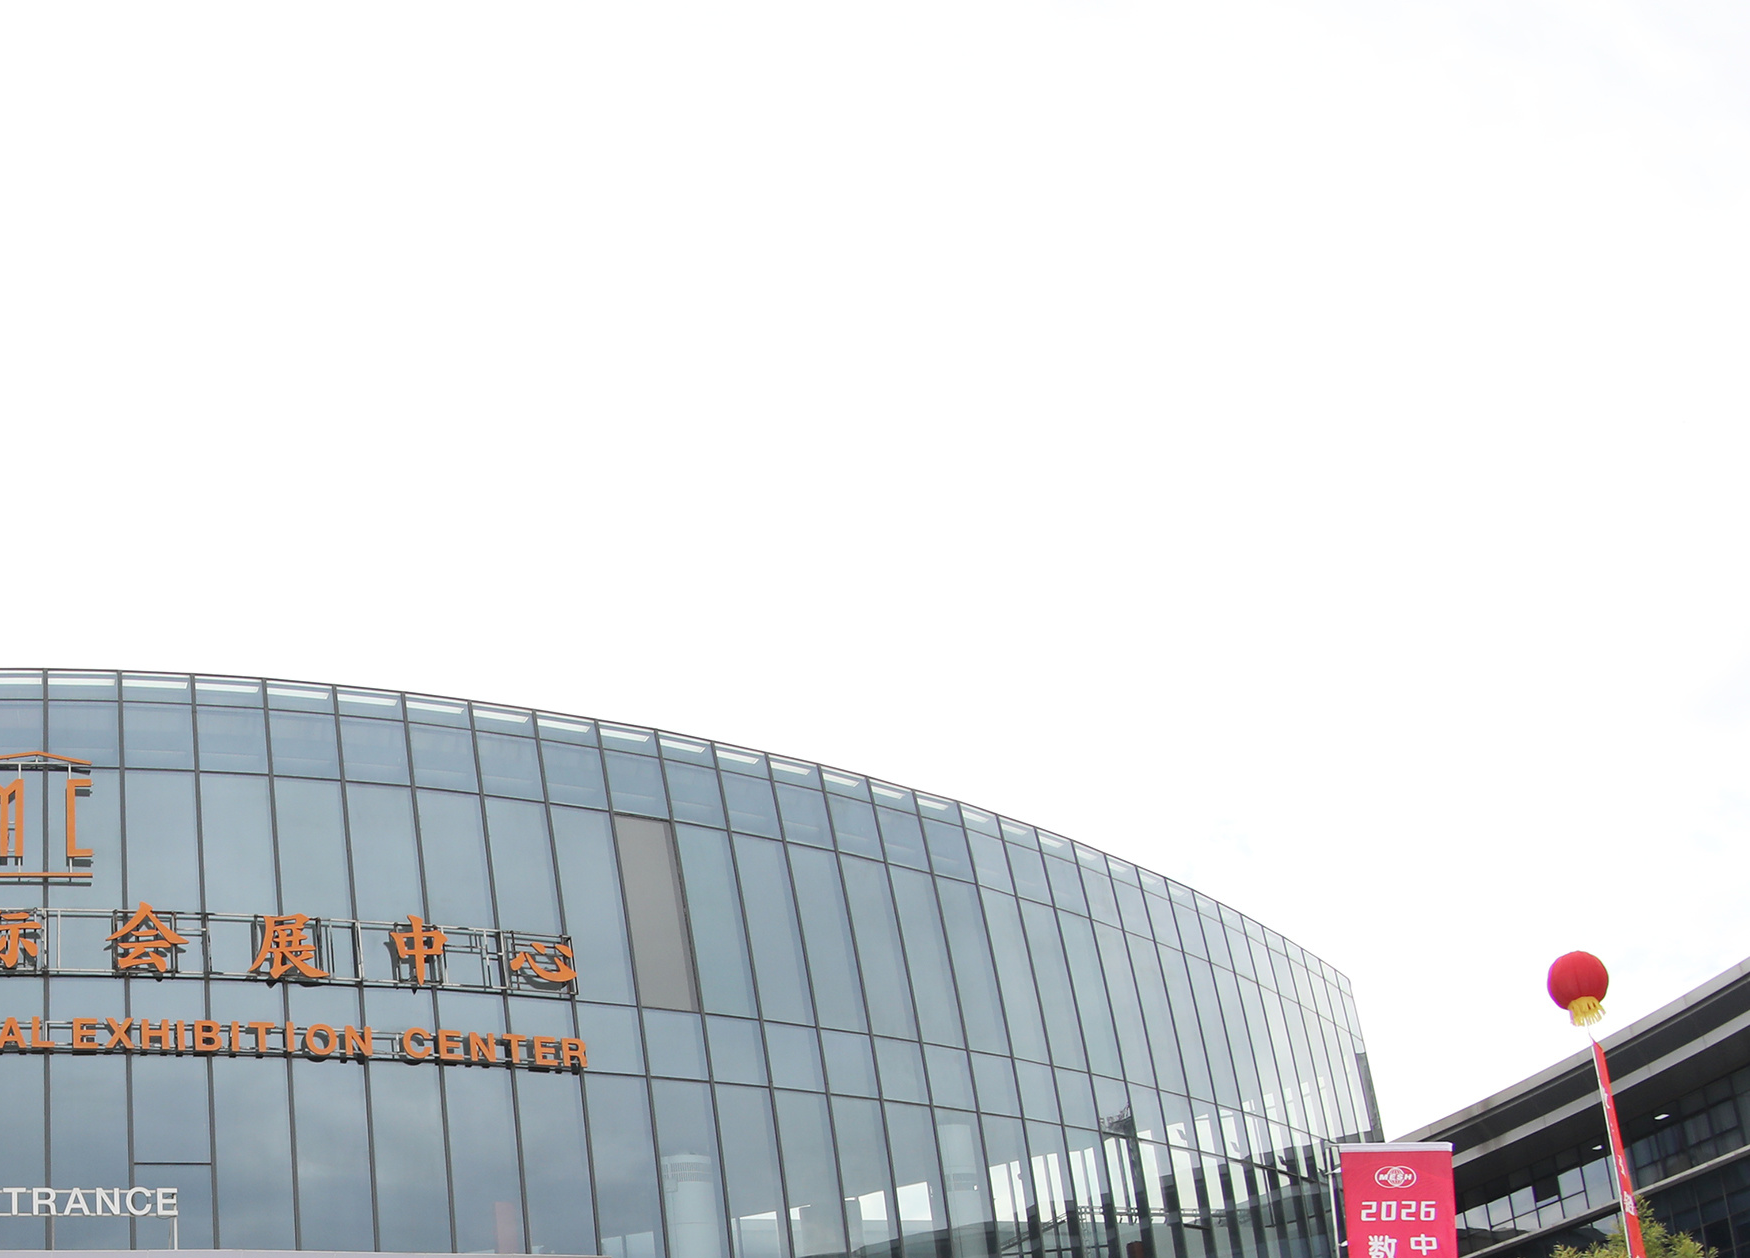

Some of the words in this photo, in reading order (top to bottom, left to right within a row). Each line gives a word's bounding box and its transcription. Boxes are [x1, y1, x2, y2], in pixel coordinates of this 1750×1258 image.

[73, 1017, 374, 1060] EXHIBITION
[402, 1026, 590, 1071] CENTER
[1379, 1173, 1413, 1181] MESH
[1360, 1201, 1437, 1222] 2026
